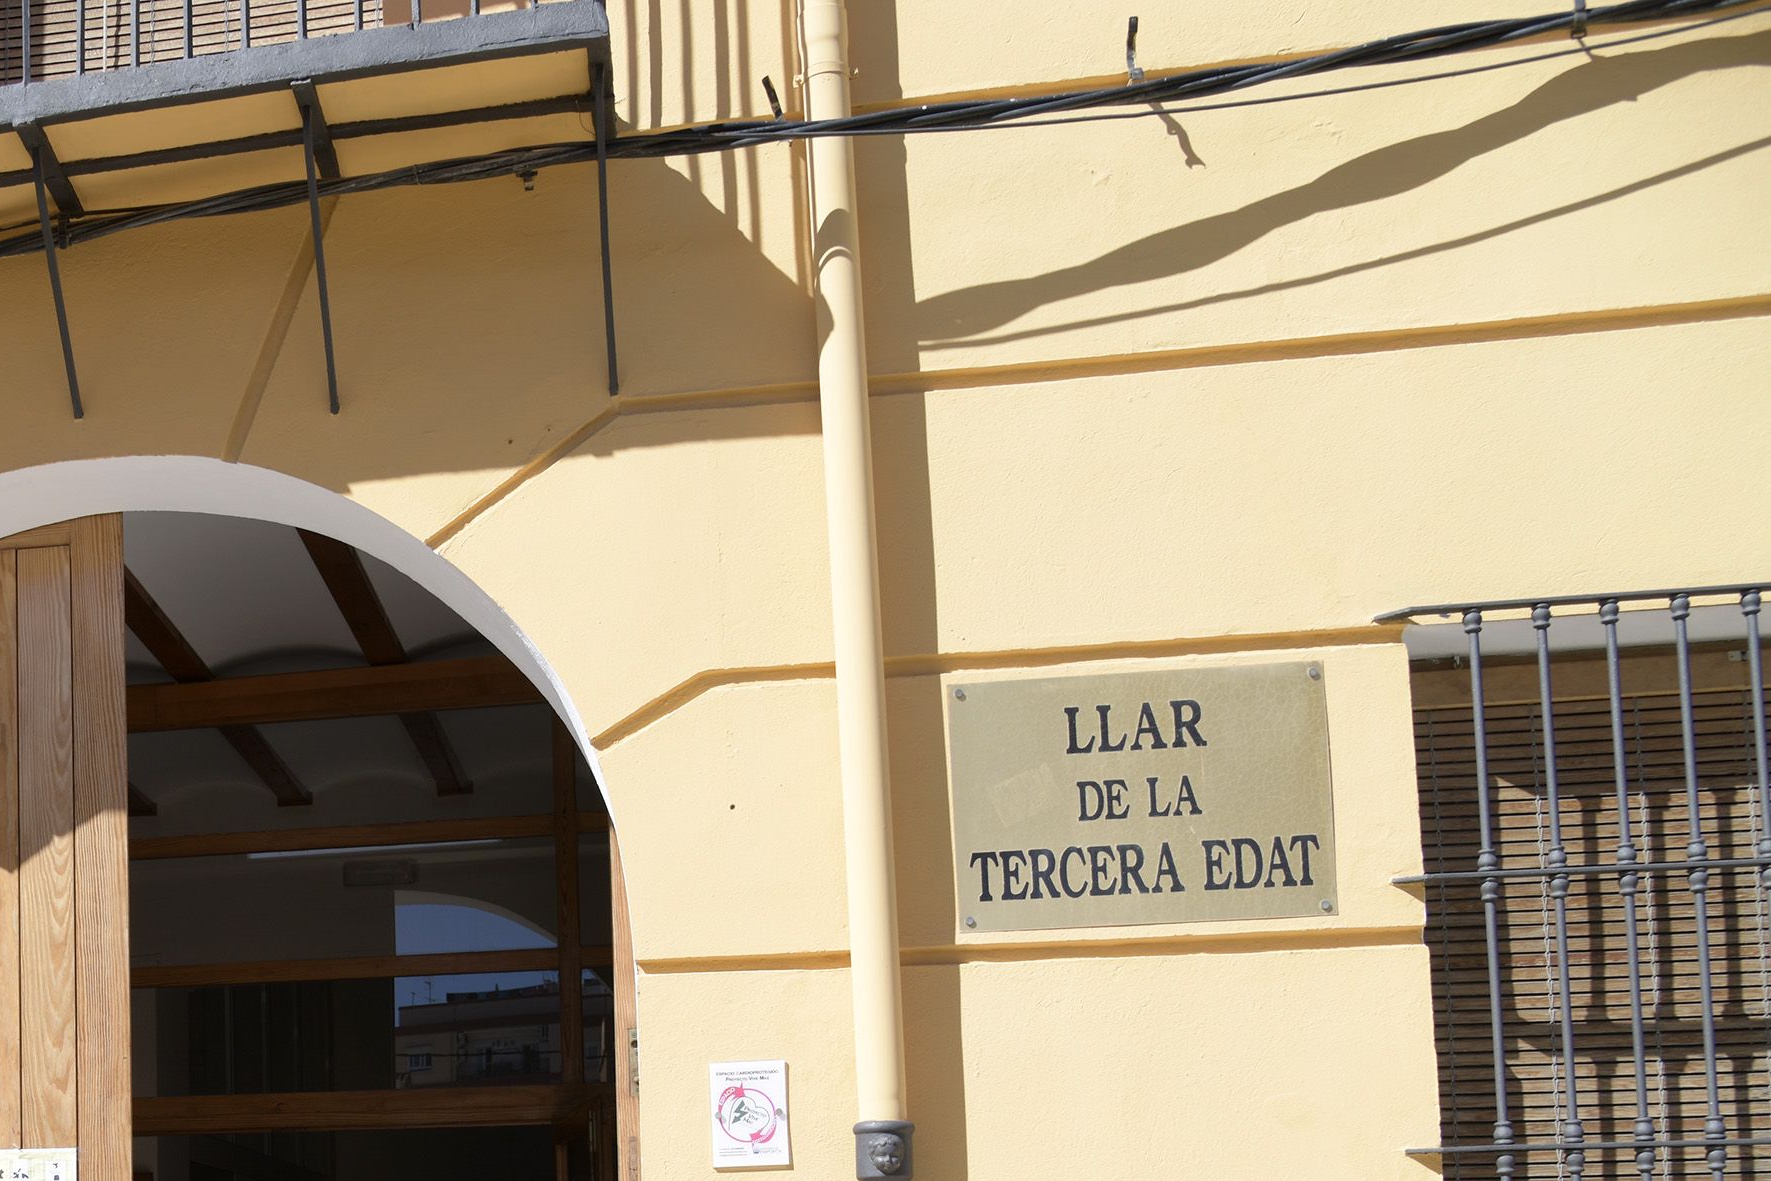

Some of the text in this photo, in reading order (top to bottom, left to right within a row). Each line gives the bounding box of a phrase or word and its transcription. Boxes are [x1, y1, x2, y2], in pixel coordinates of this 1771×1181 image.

[1064, 699, 1207, 754] LLAR
[1076, 774, 1203, 821] DE LA
[969, 834, 1320, 902] TERCERA EDAT
